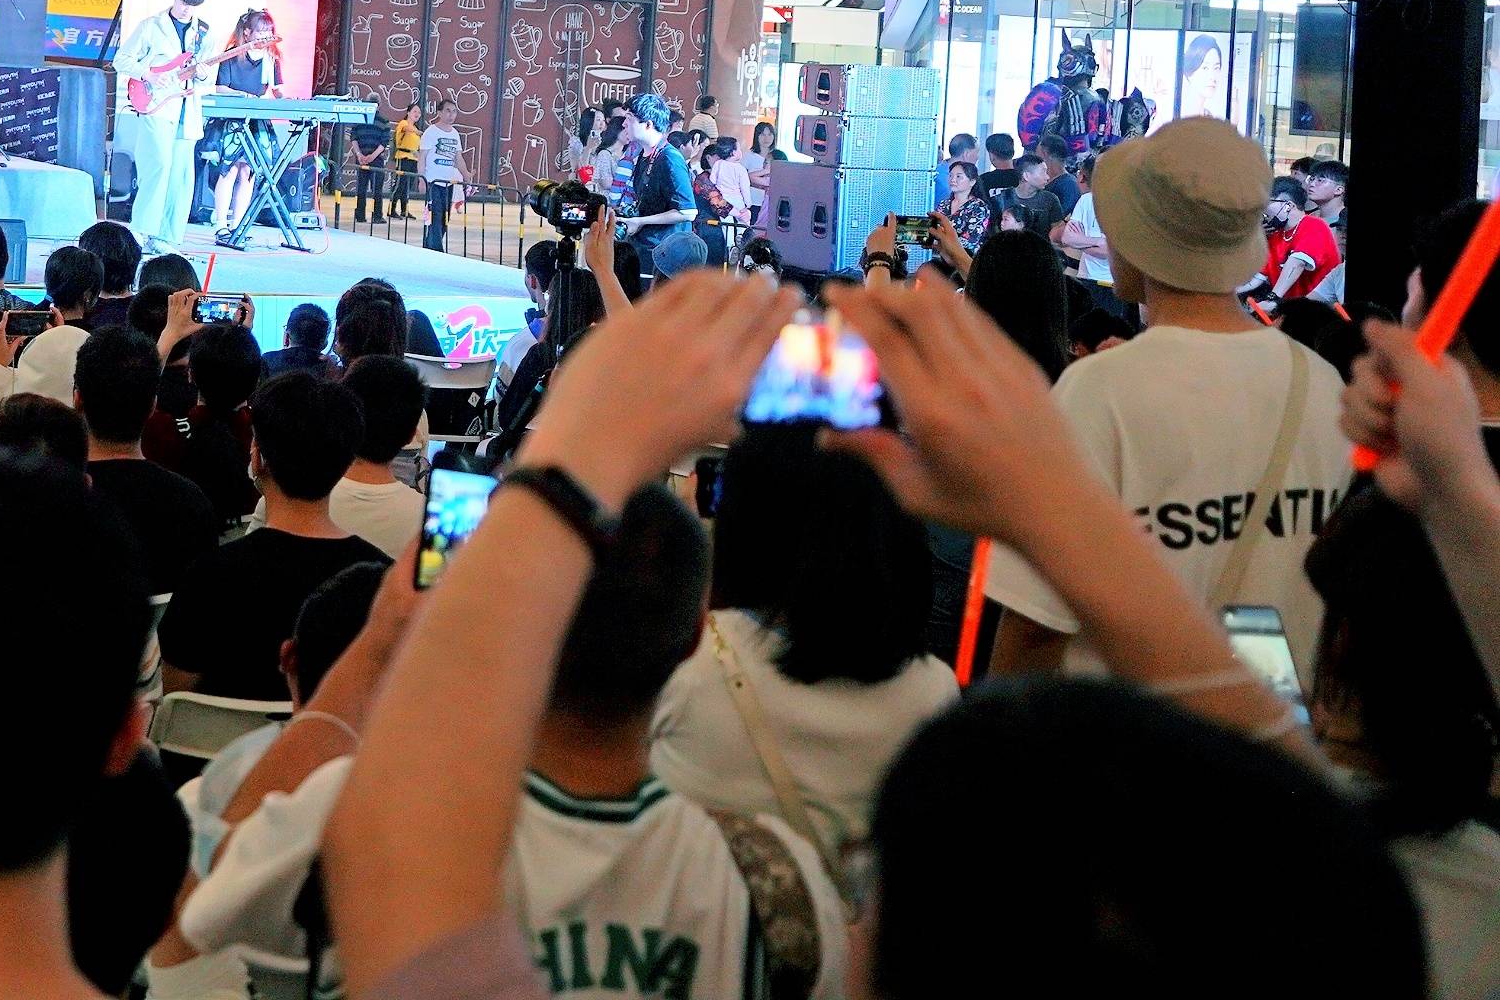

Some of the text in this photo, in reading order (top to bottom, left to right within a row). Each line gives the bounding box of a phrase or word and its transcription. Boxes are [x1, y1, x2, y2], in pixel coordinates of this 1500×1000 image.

[392, 12, 418, 31] Sugar
[460, 16, 485, 34] Sugar
[1133, 487, 1342, 550] SSENTI
[532, 921, 700, 1000] HINA
